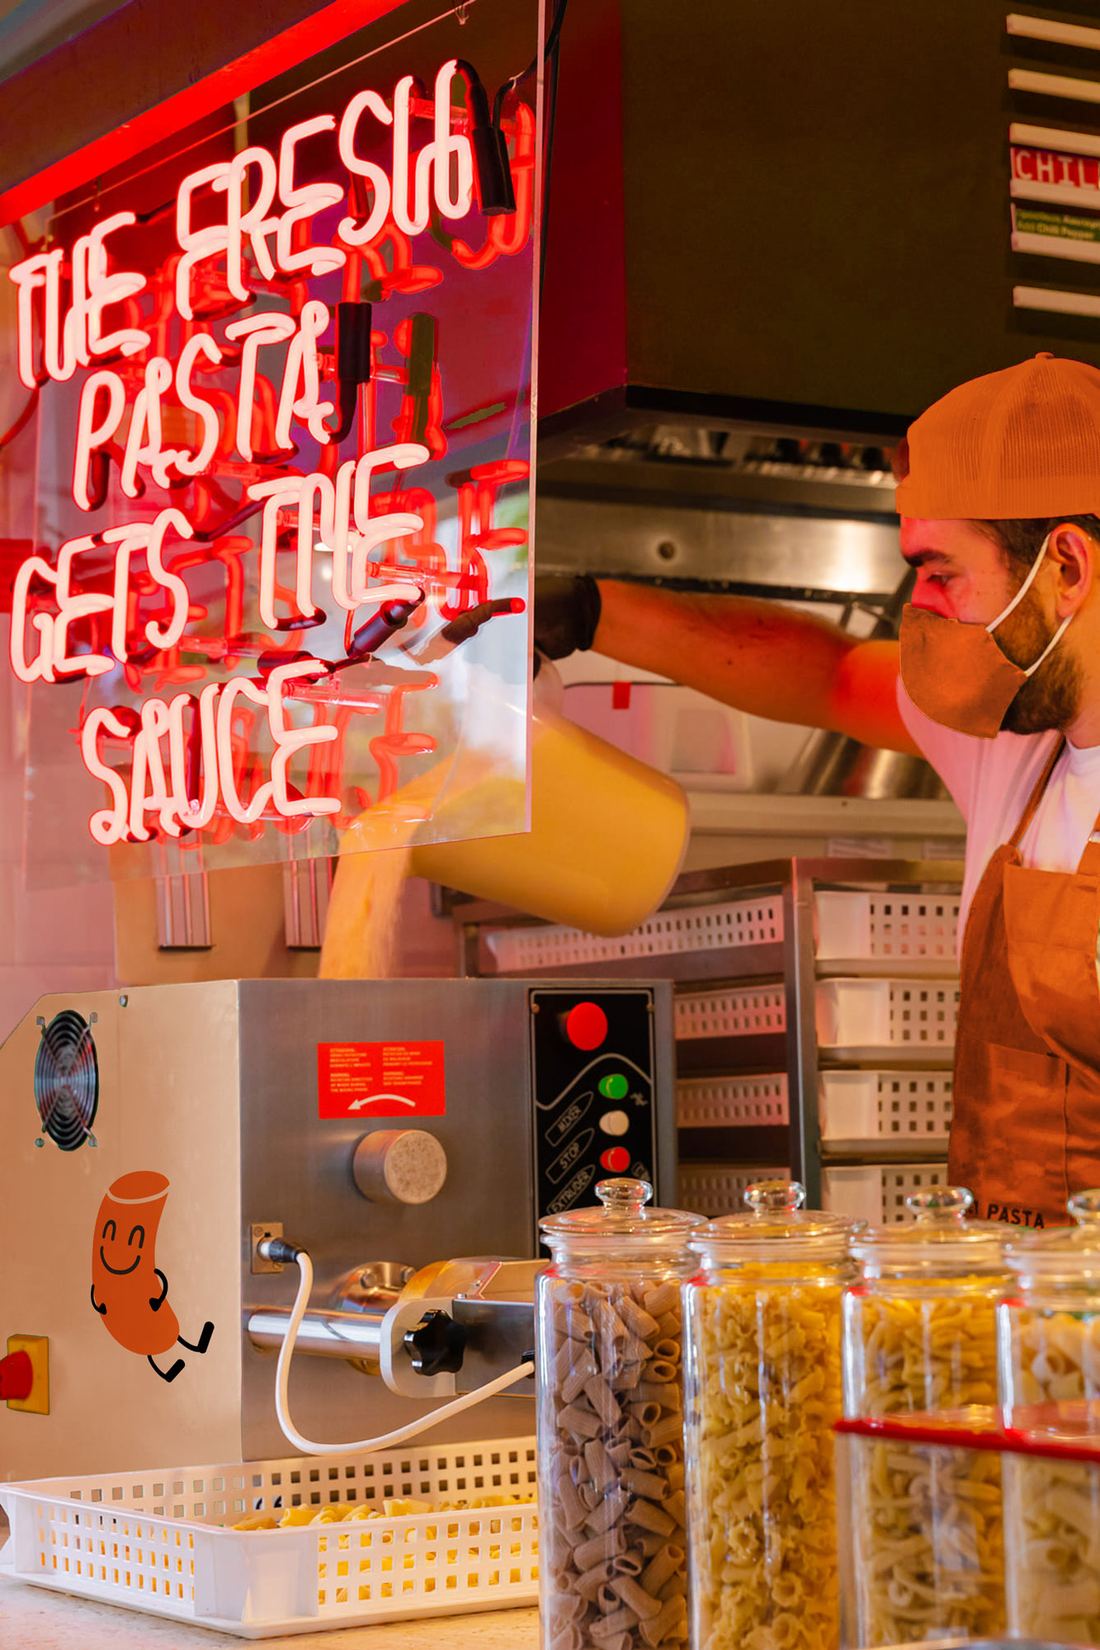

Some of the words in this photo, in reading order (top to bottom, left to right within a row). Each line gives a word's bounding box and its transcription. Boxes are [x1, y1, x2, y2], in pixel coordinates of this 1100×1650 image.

[1016, 150, 1100, 191] CHIL
[9, 211, 151, 389] THE
[176, 58, 475, 321] FRESH
[72, 300, 333, 511] PASTA
[9, 508, 195, 684] GETS
[248, 443, 430, 630] THE
[81, 658, 341, 846] SAUCE
[557, 1104, 582, 1134] MIXER
[559, 1141, 581, 1170] STOP
[551, 1170, 590, 1213] EXTRUDER
[986, 1203, 1045, 1229] PASTA
